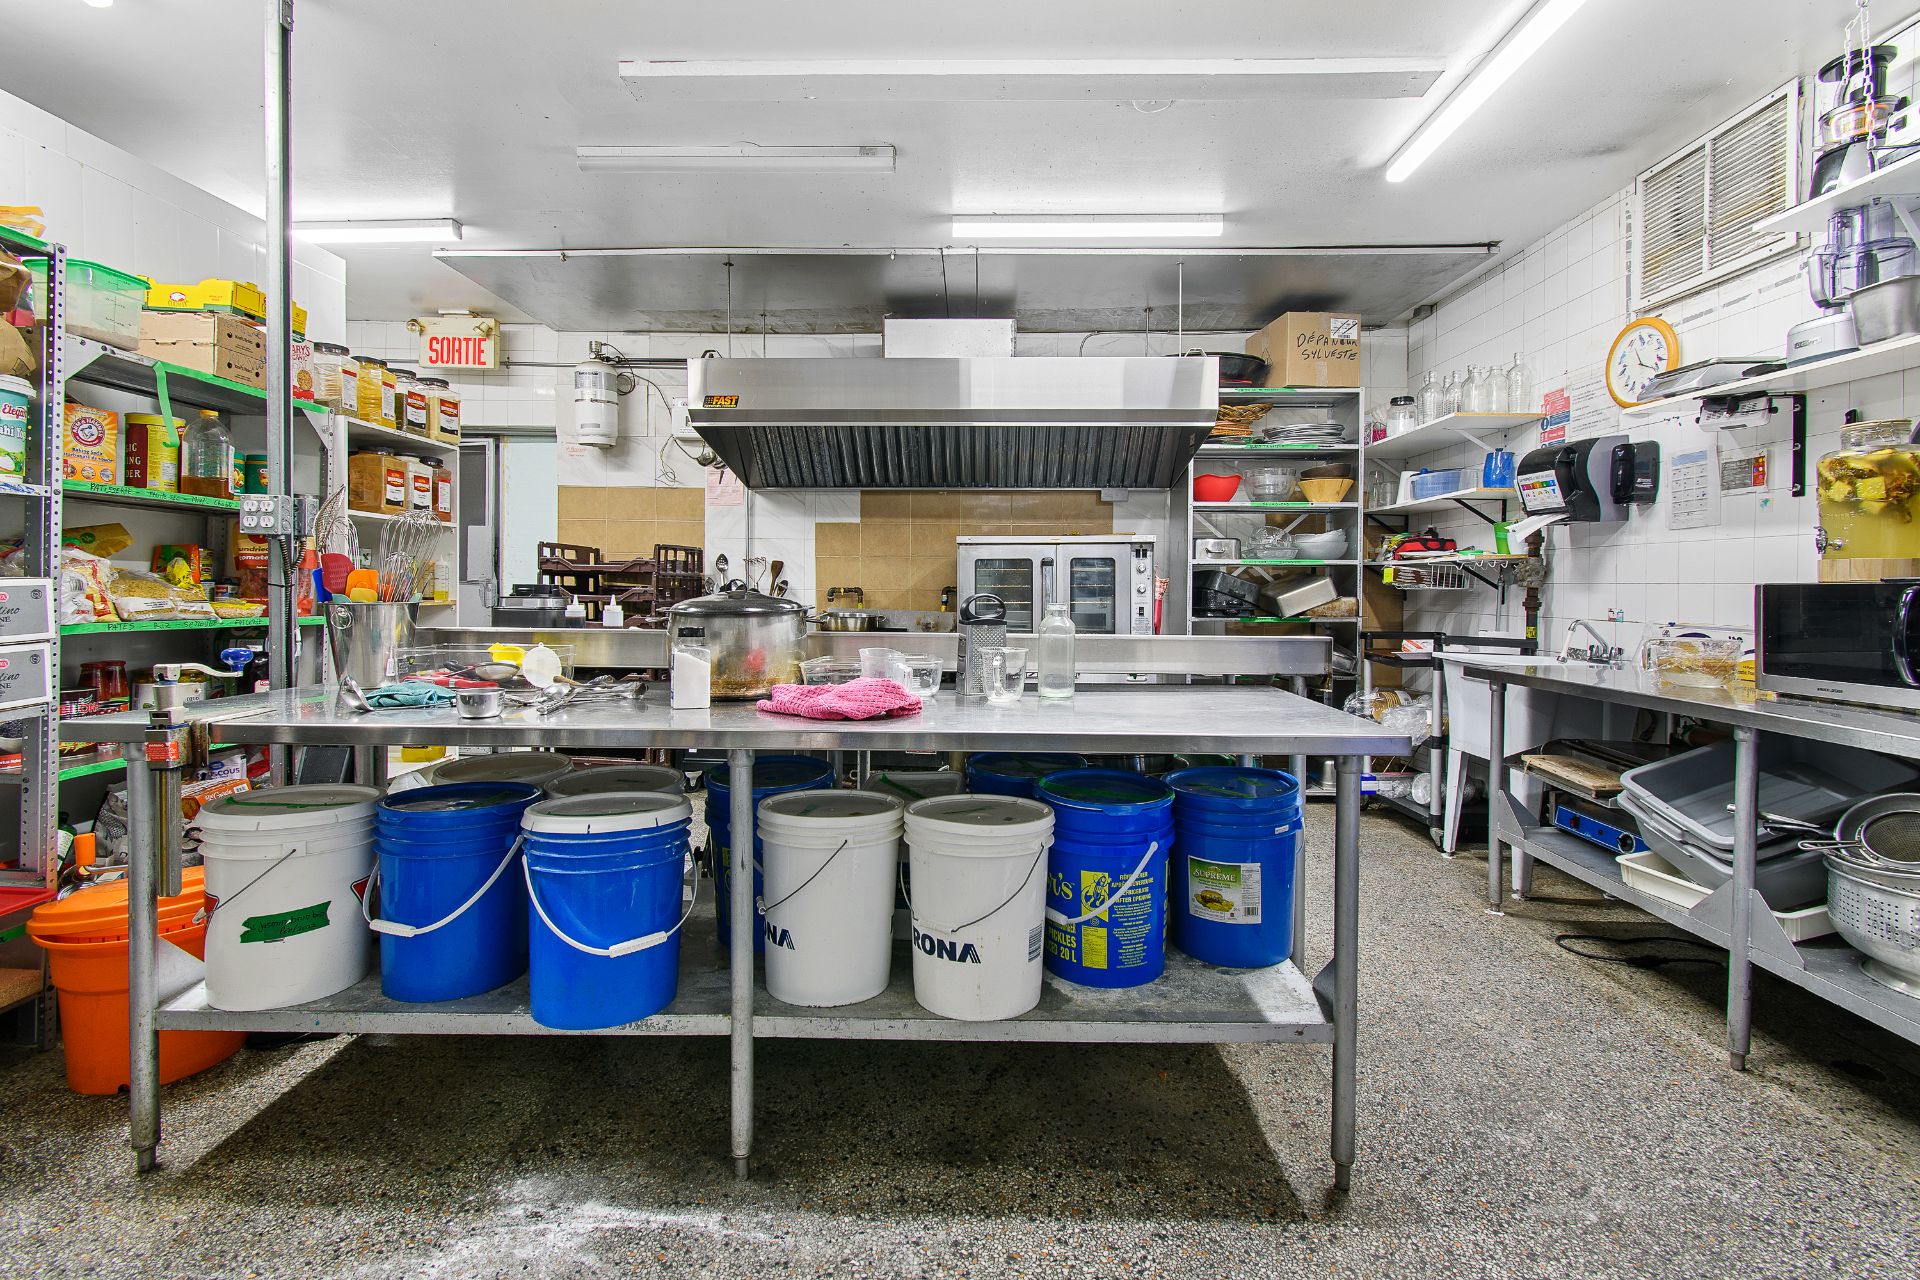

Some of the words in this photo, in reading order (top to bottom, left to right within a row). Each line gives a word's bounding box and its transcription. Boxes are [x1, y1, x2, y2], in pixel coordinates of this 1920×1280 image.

[428, 336, 487, 366] SORTIE
[712, 396, 737, 405] FAST
[1193, 867, 1236, 881] SUPREME
[764, 920, 795, 951] NA
[912, 925, 981, 964] RONA
[1060, 945, 1070, 961] 20
[1071, 949, 1077, 963] L
